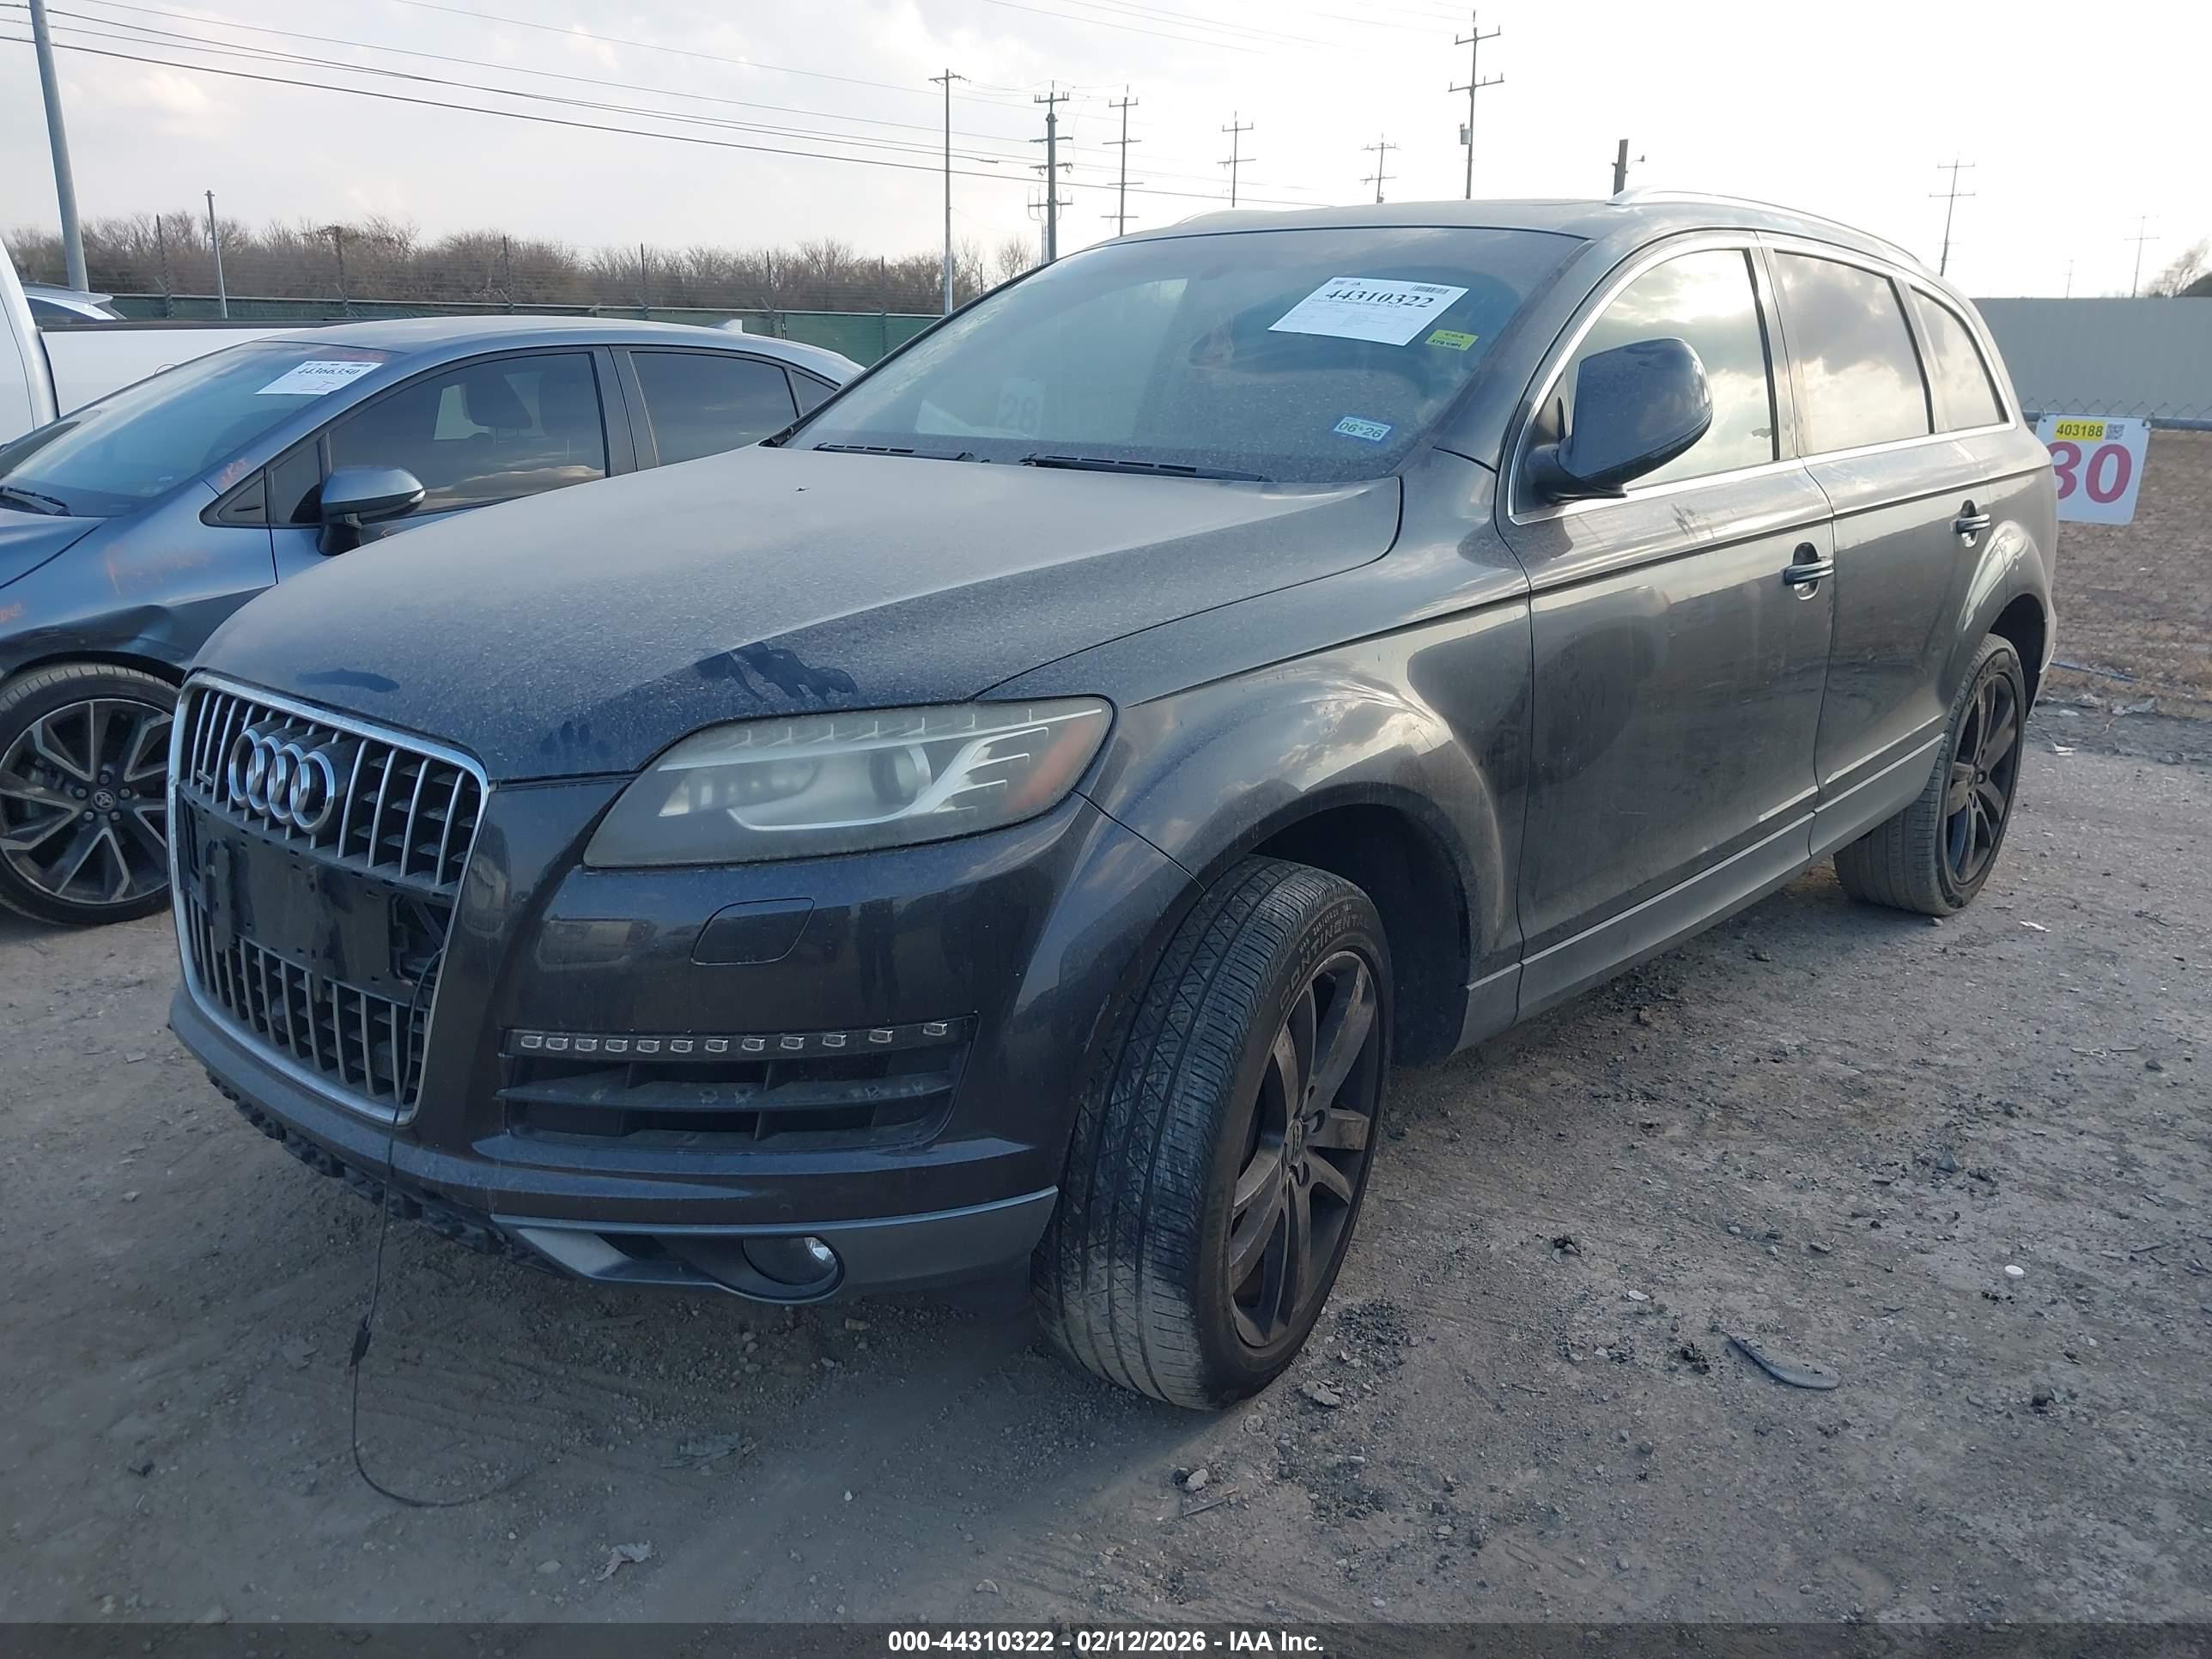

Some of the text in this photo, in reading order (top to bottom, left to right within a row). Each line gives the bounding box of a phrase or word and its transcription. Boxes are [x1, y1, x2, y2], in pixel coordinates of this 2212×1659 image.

[1325, 289, 1435, 309] 44310322
[2056, 422, 2104, 437] 403188
[2046, 441, 2132, 504] 30
